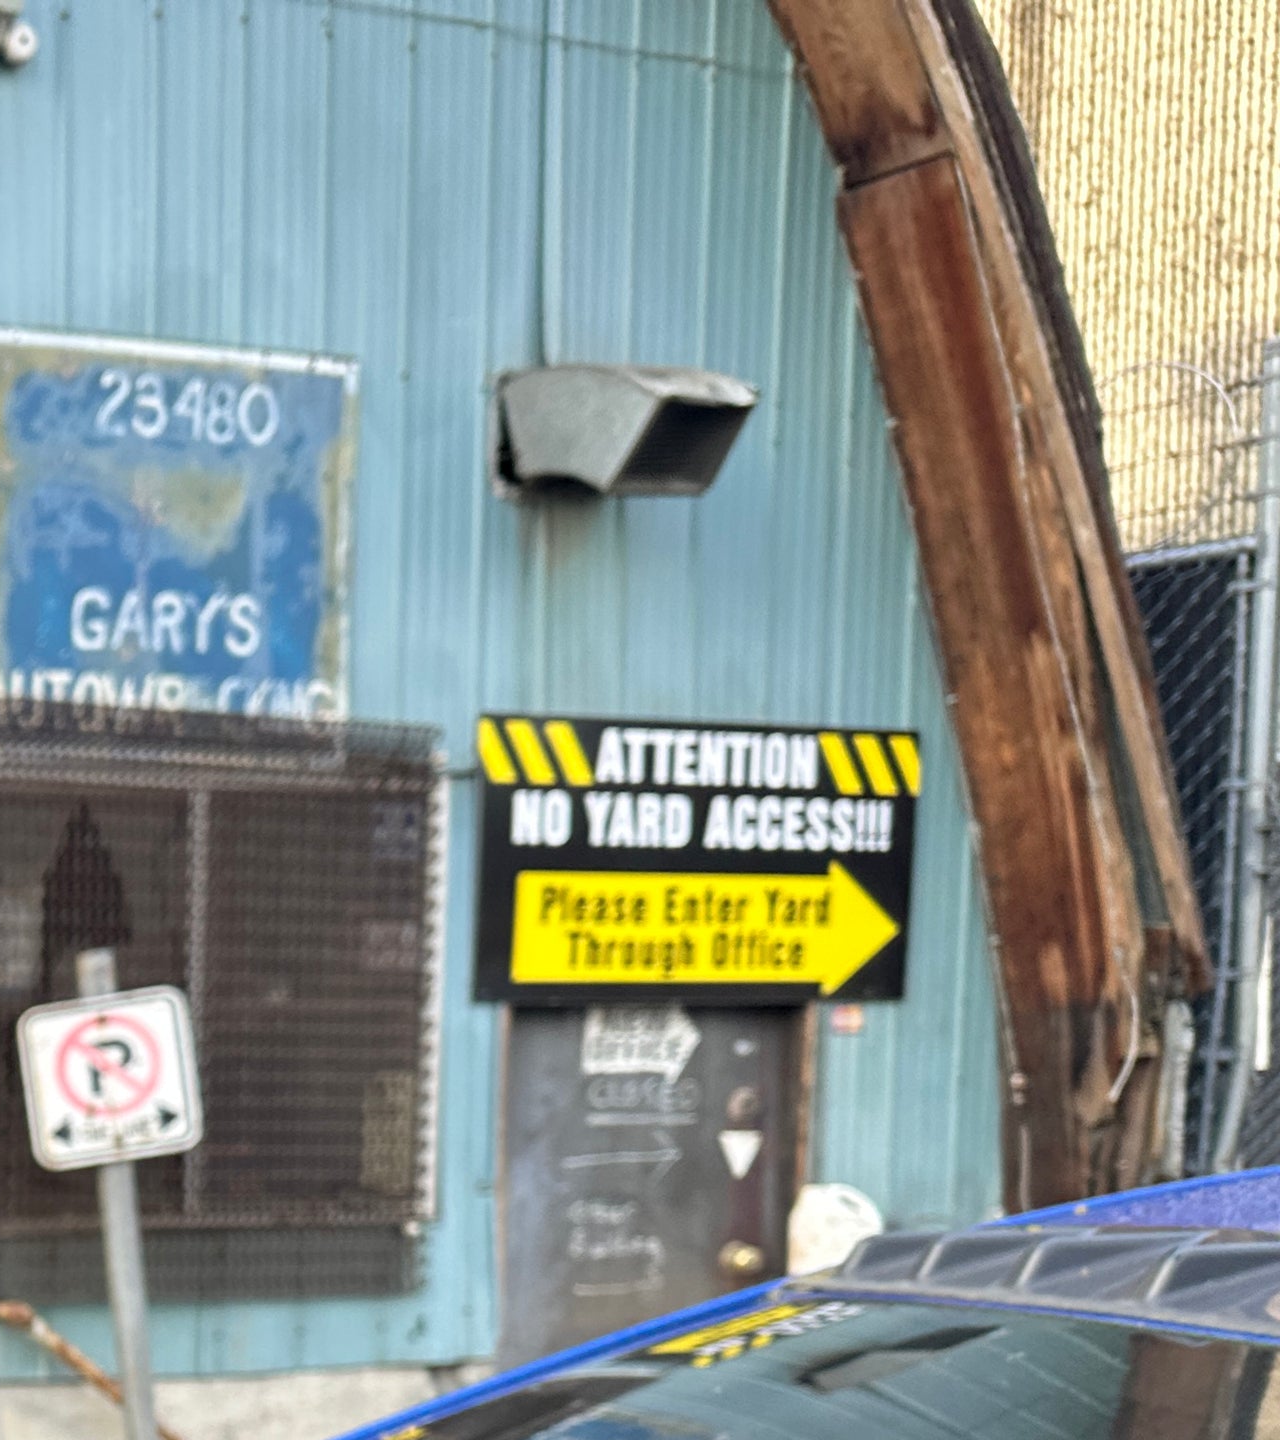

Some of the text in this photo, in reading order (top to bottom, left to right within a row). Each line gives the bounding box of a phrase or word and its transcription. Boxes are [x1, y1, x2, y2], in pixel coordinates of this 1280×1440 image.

[96, 368, 280, 446] 23480
[595, 726, 820, 790] ATTENTION
[510, 789, 894, 852] NO YARD ACCESS!!!
[541, 886, 831, 925] Please Enter Yard
[569, 931, 805, 979] Through Office
